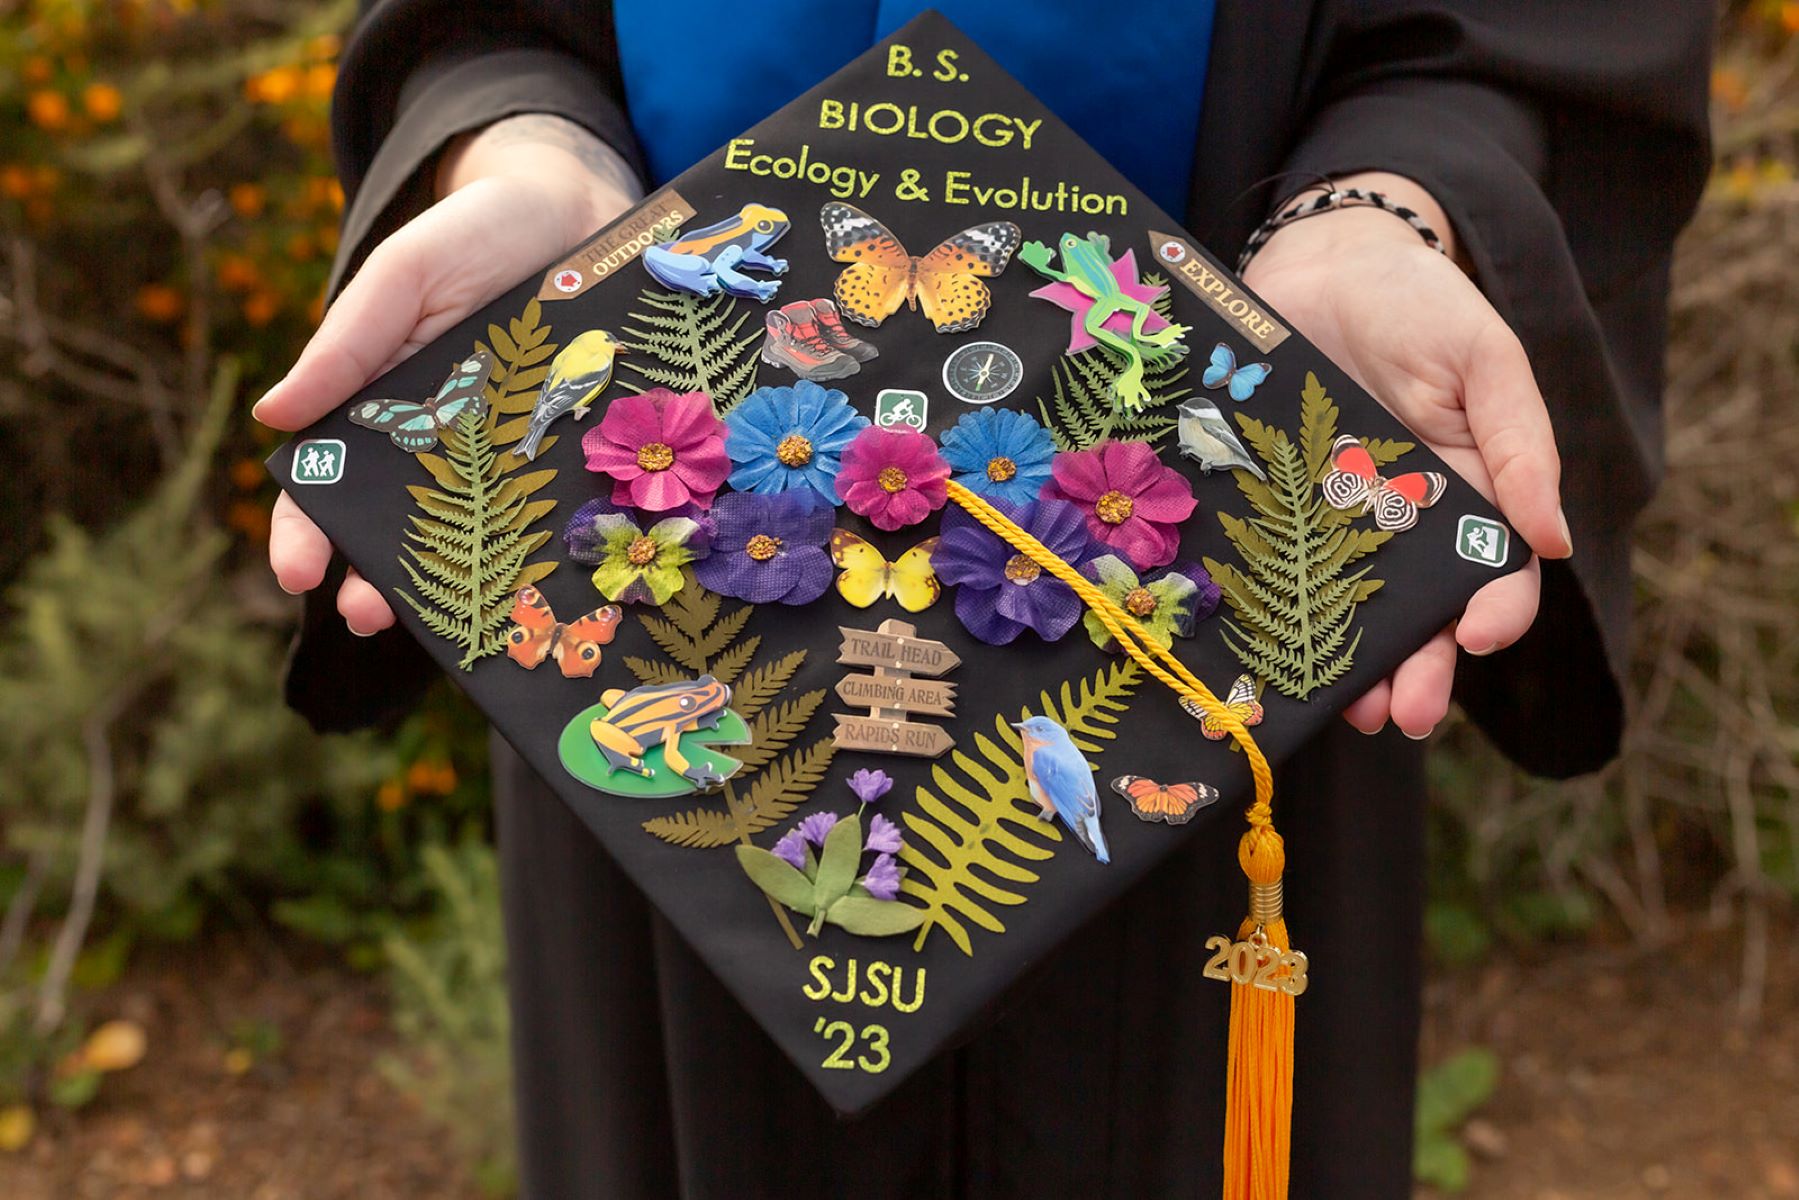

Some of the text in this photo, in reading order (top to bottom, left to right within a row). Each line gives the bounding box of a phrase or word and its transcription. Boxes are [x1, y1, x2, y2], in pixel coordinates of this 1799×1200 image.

[887, 44, 970, 82] B. S.
[819, 99, 1042, 150] BIOLOGY
[724, 138, 1128, 215] Ecology & Evolution
[583, 203, 668, 263] THE GREAT
[1179, 258, 1275, 339] EXPLORE
[851, 638, 942, 667] TRAIL HEAD
[843, 681, 942, 706] CLIMBING AREA
[844, 723, 938, 749] RAPIDS RUN
[802, 955, 926, 1013] SJSU
[1202, 934, 1309, 996] 2023
[813, 1016, 891, 1074] '23
